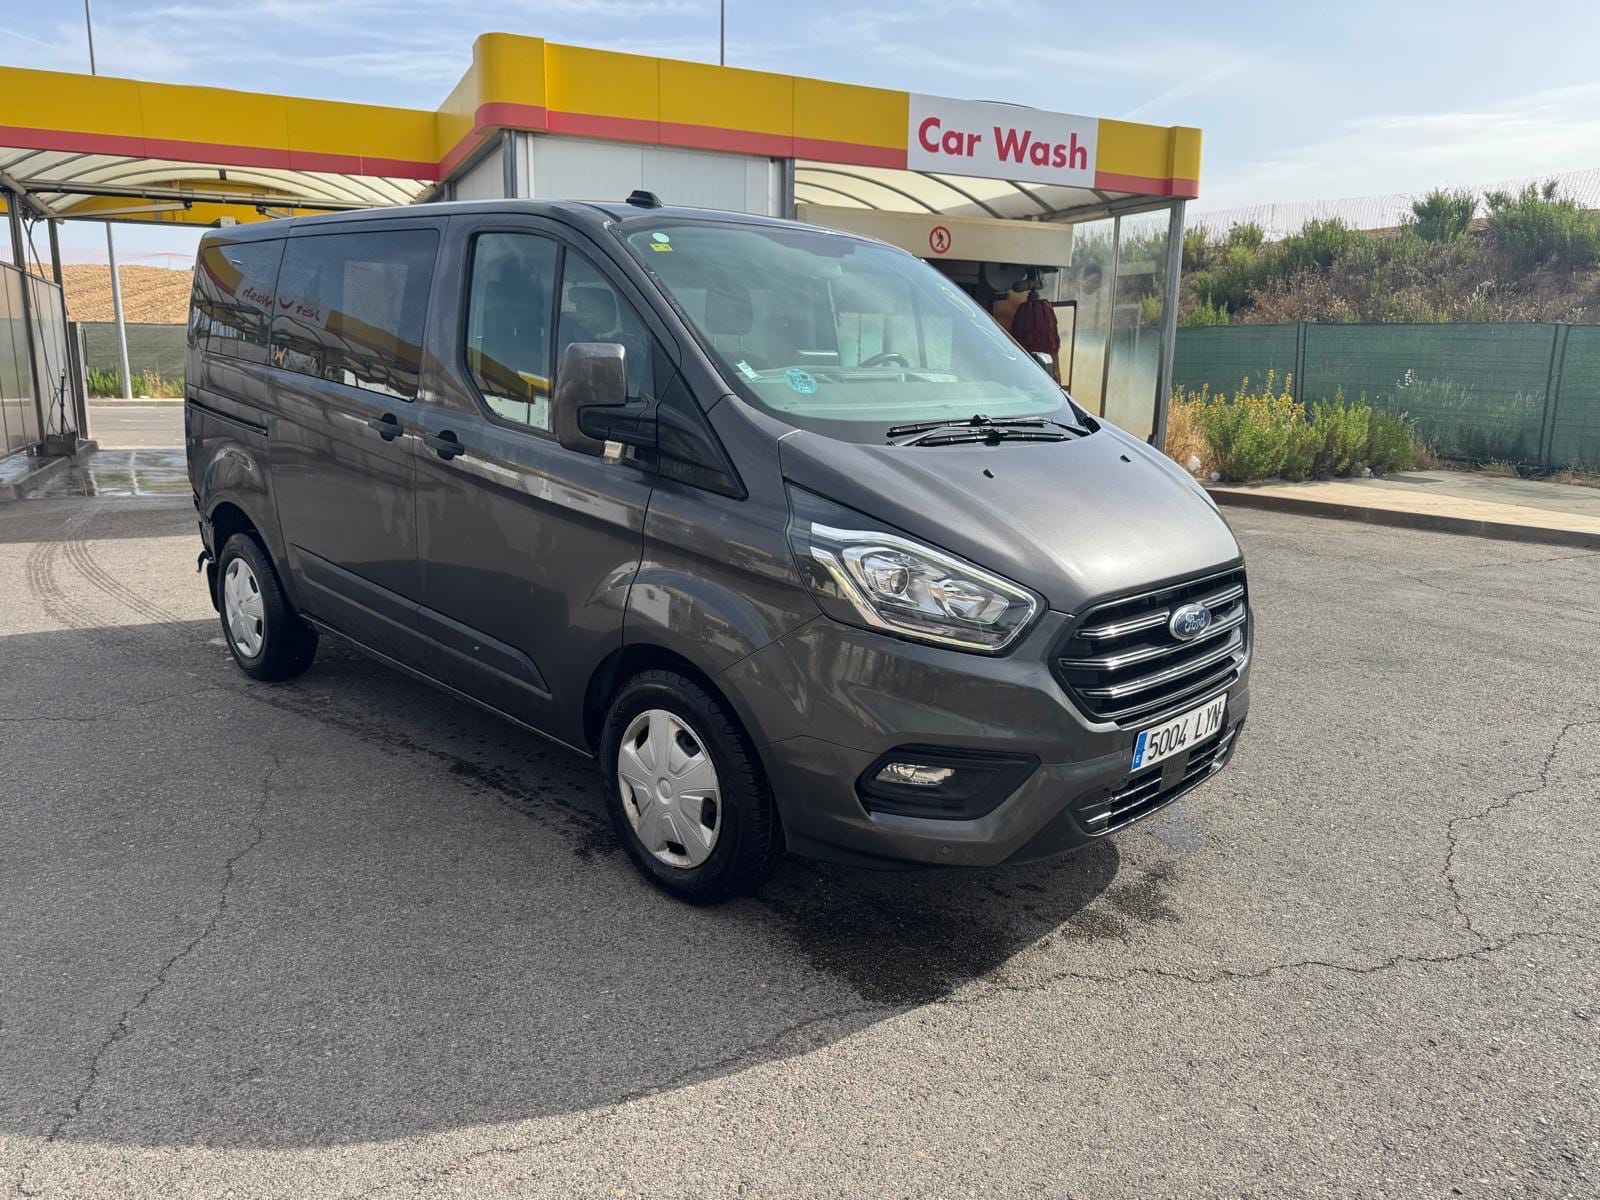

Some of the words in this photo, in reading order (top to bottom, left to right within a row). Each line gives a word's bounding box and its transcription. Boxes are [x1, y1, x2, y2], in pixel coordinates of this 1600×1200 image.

[918, 117, 981, 156] Car
[993, 126, 1088, 170] Wash
[1147, 718, 1189, 761] 5004
[1194, 701, 1222, 740] LYN
